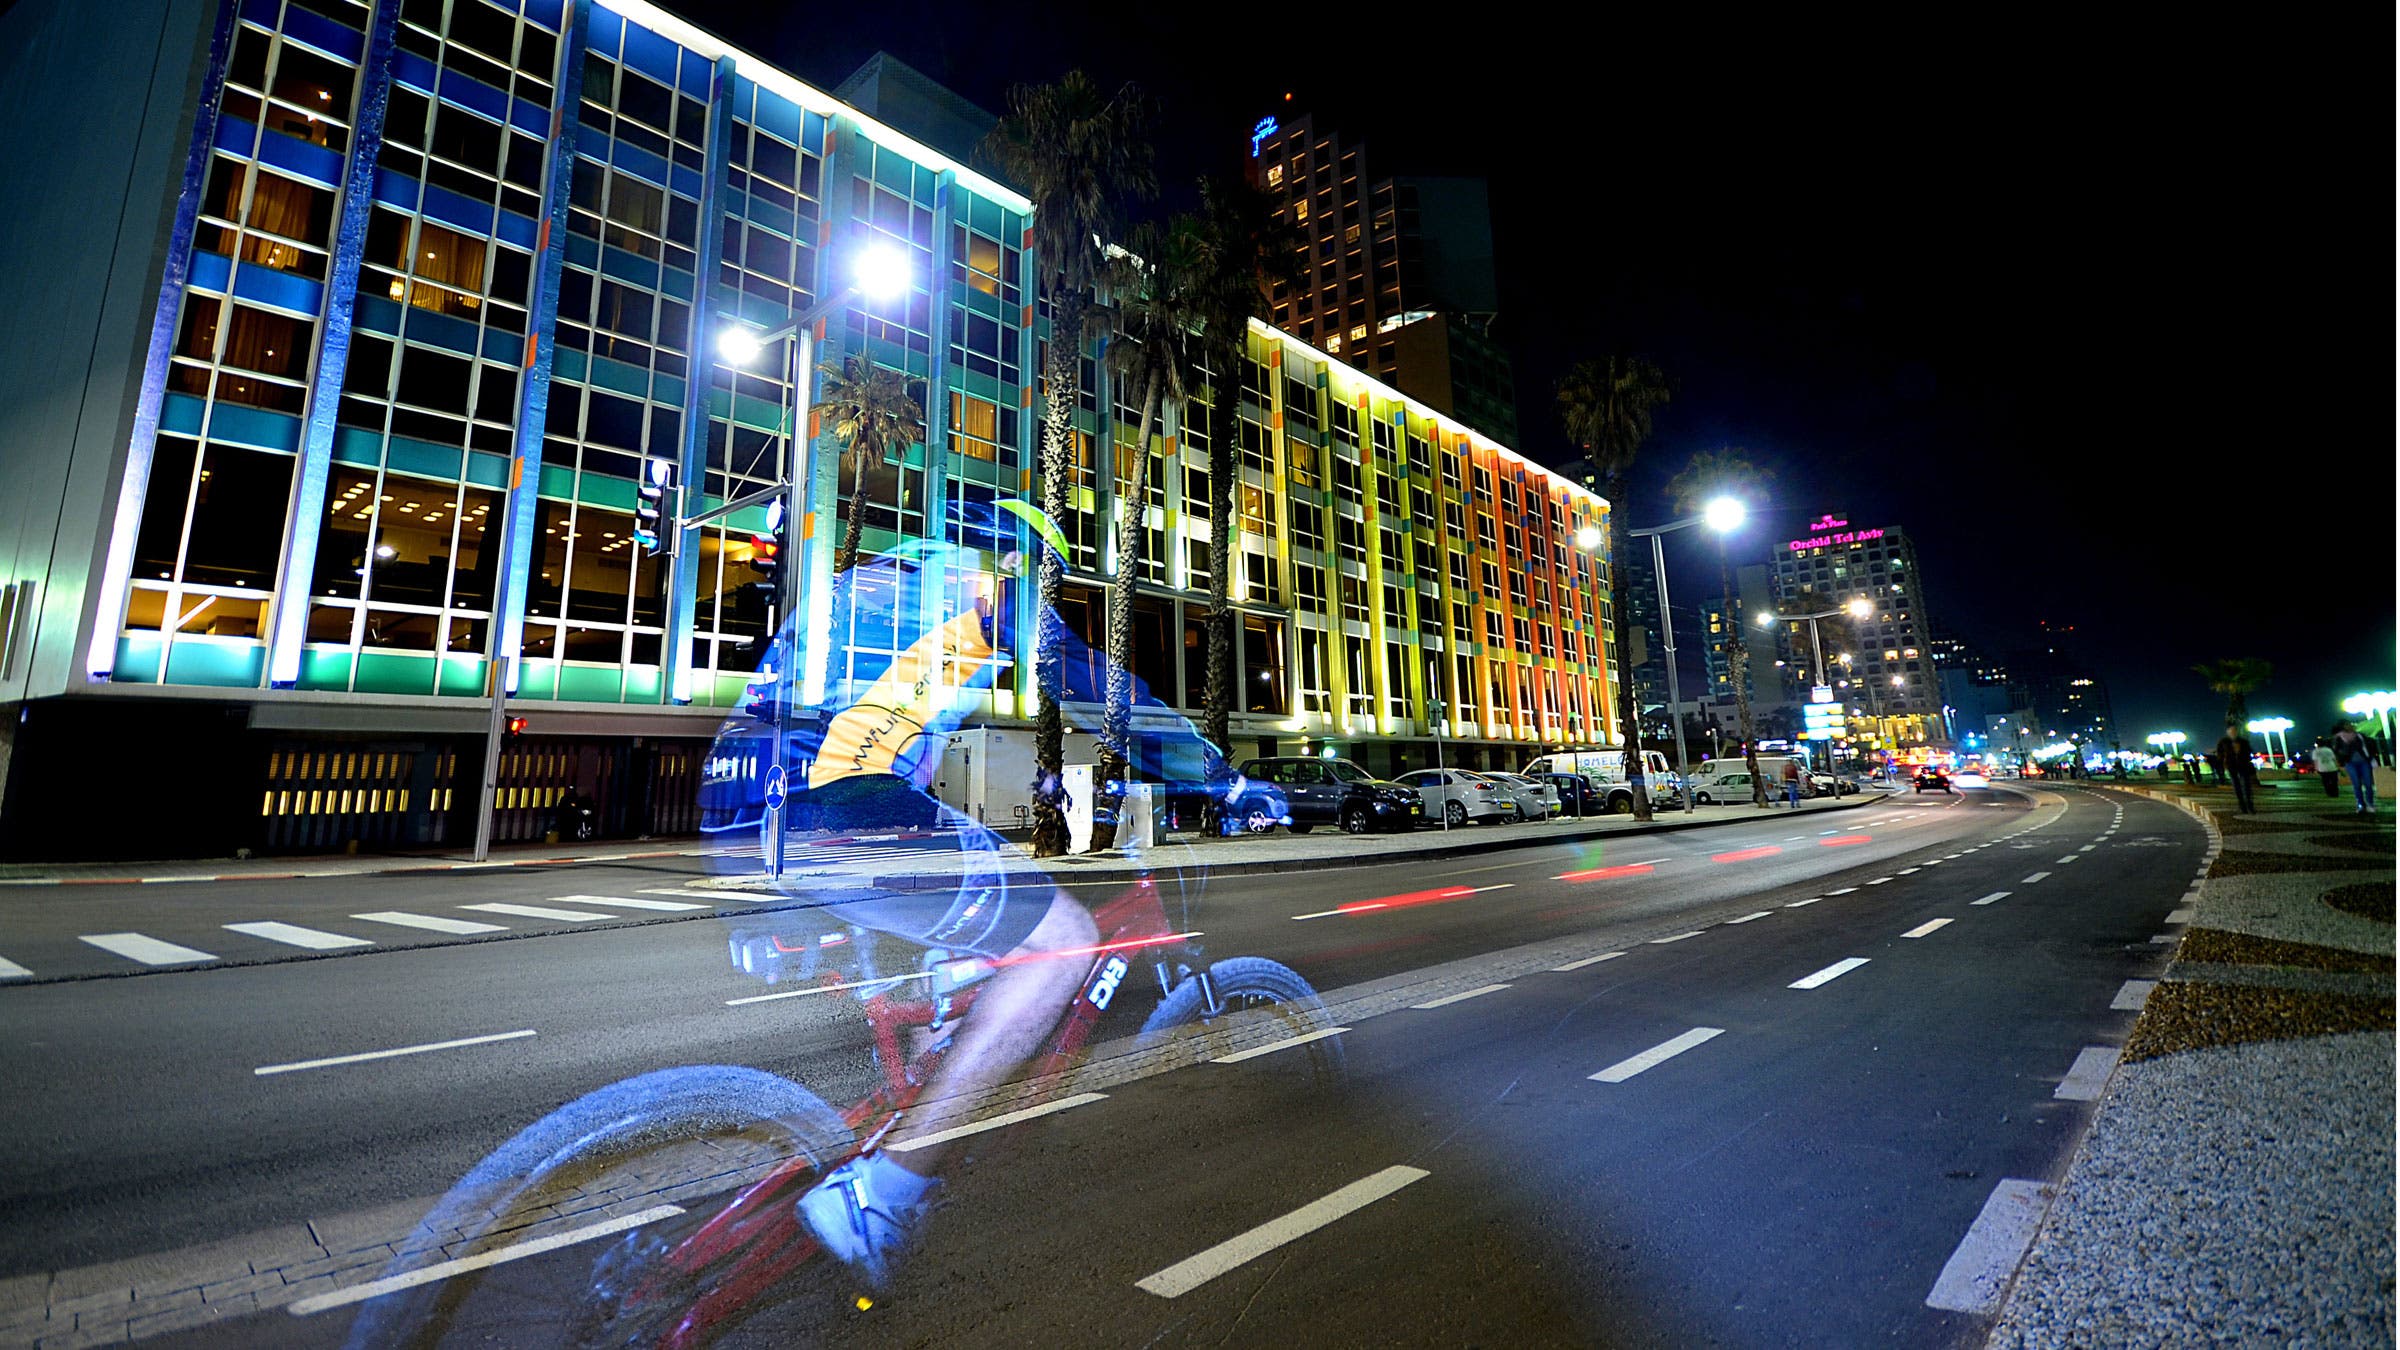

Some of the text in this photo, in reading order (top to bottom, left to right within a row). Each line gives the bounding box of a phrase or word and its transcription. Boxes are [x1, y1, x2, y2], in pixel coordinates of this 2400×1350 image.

[1789, 529, 1884, 551] Orchid Tel Aviv
